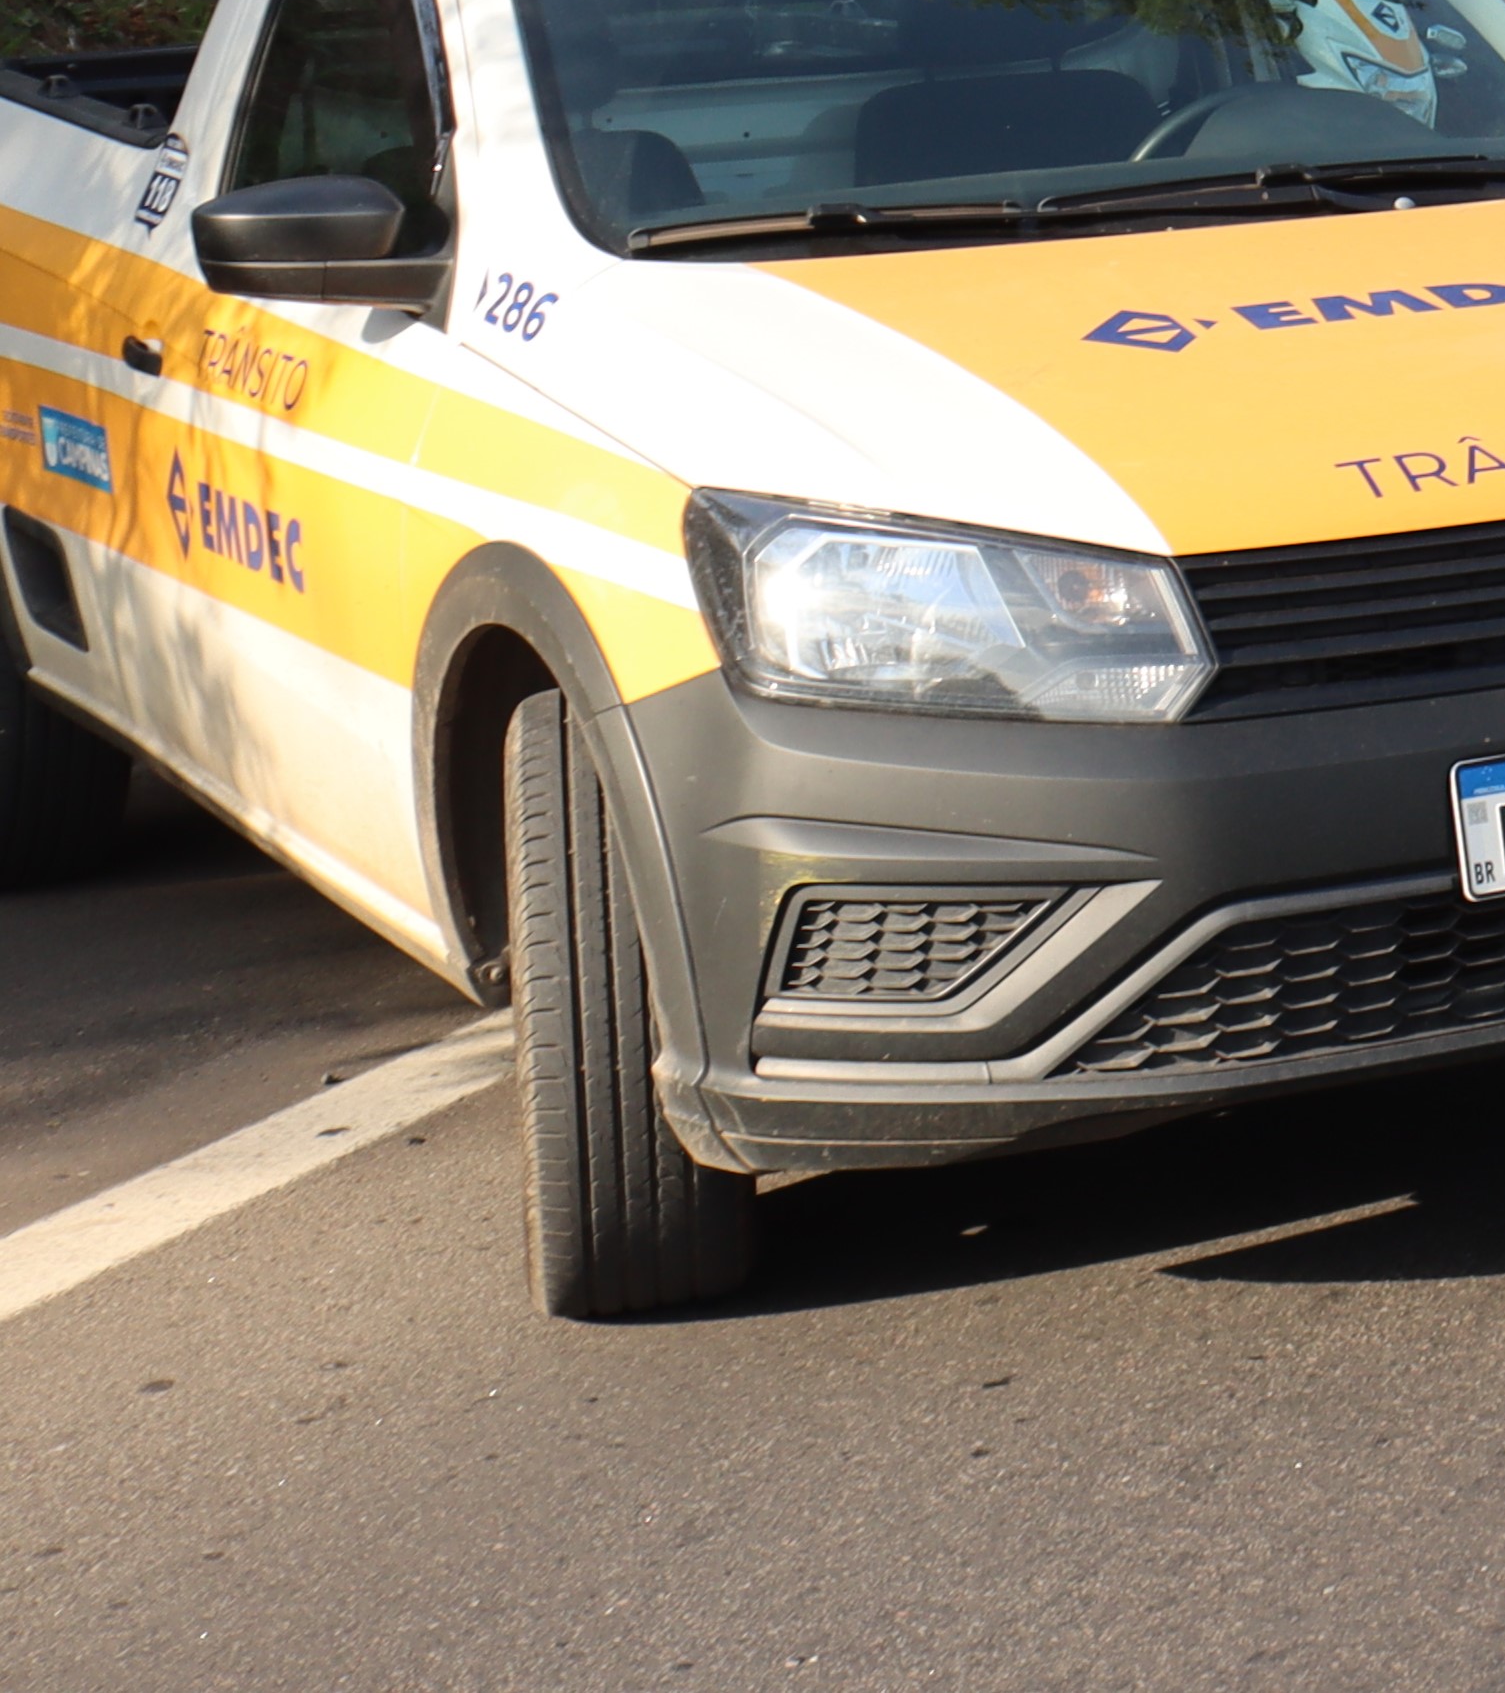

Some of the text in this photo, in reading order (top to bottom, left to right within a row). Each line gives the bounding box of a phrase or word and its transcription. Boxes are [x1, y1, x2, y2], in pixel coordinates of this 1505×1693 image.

[484, 271, 559, 342] 286
[200, 326, 308, 411] TRÂNSITO
[197, 481, 304, 593] EMDEC
[1474, 860, 1496, 885] BR
